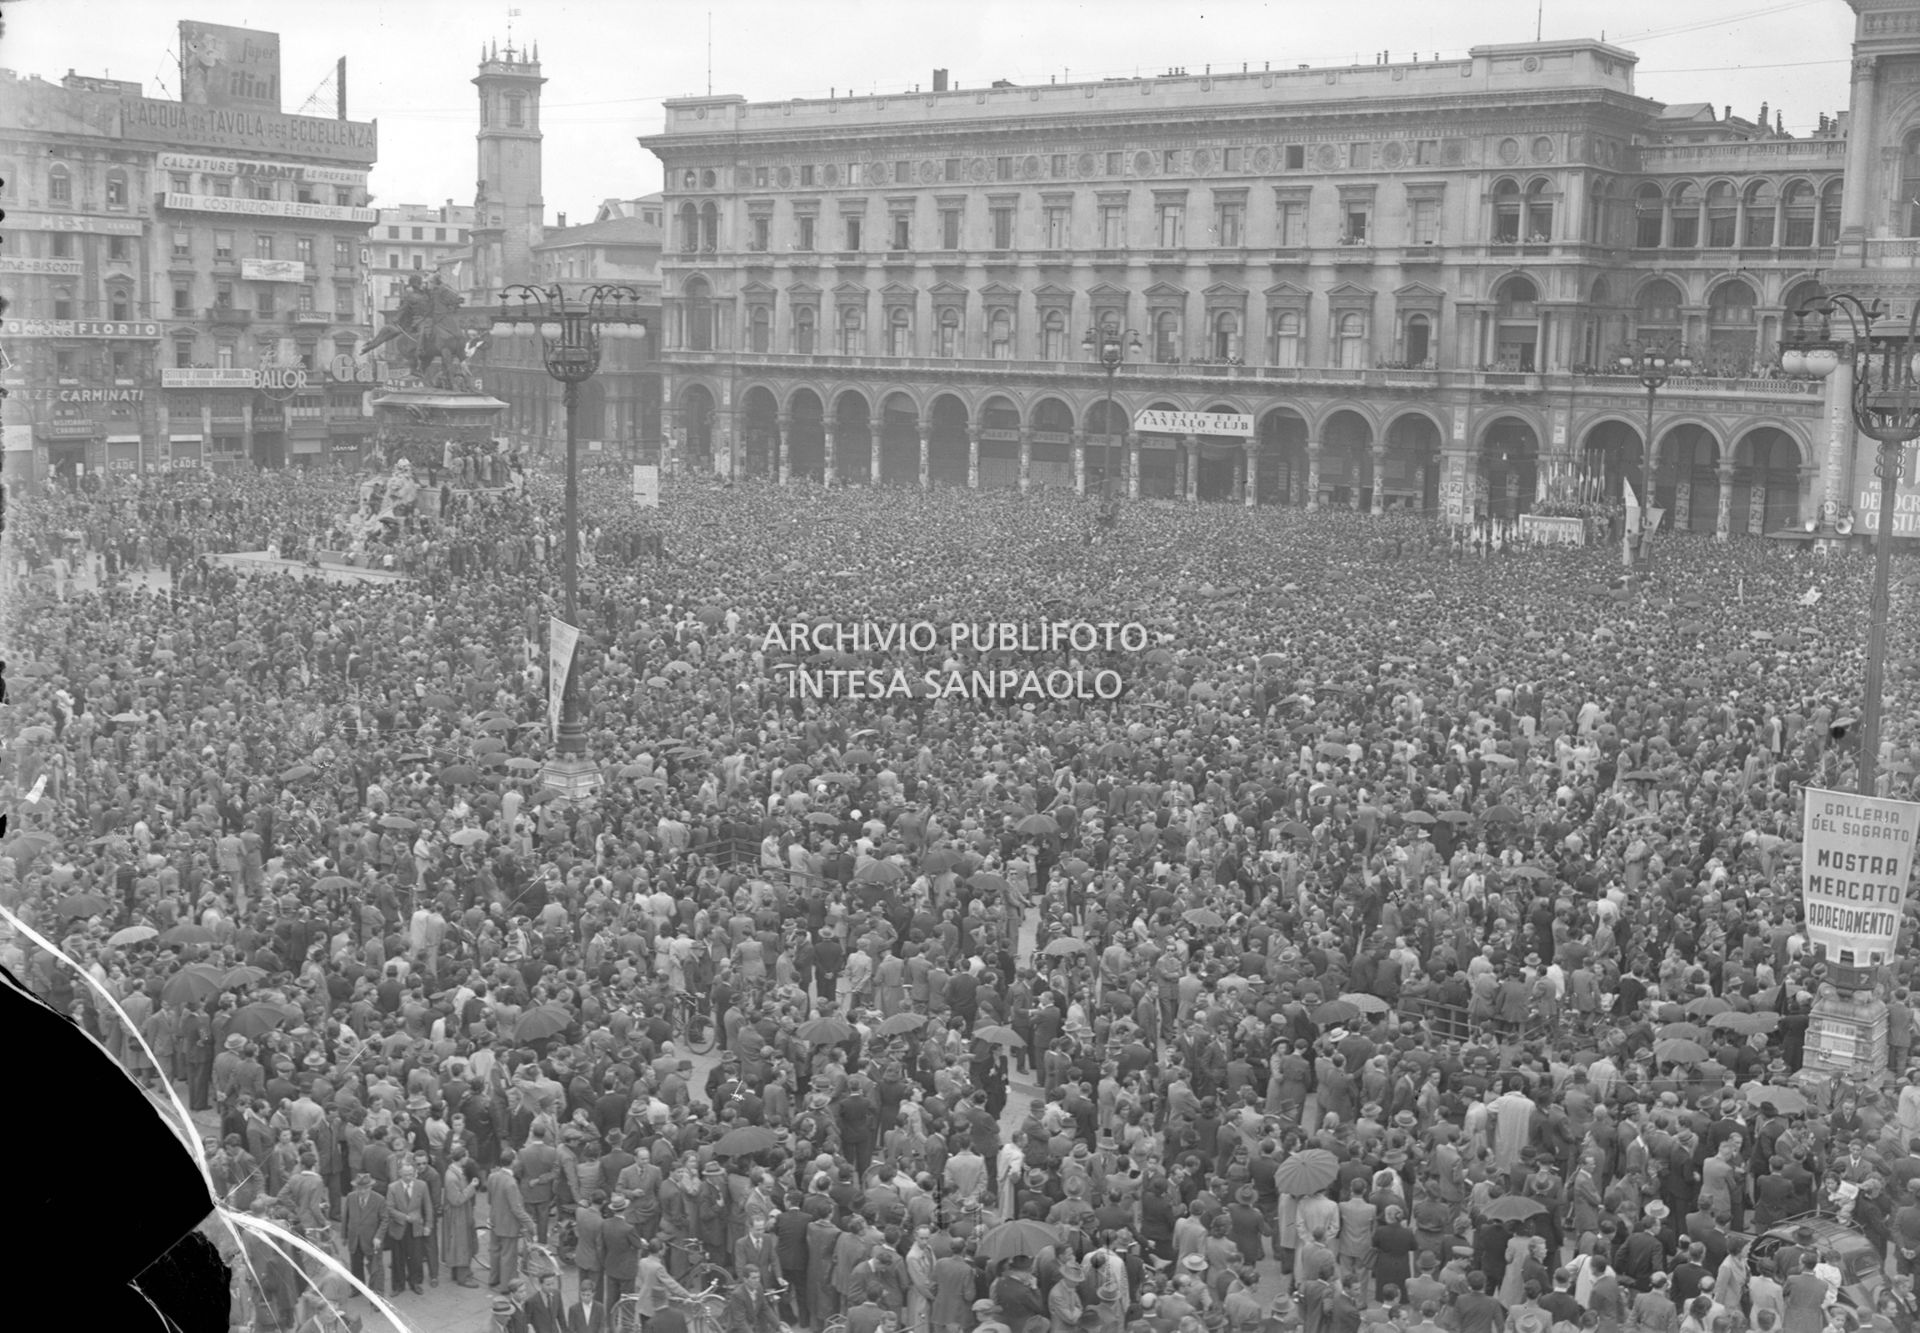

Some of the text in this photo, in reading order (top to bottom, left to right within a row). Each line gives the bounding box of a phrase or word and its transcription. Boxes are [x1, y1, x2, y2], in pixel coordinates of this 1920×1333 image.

[127, 102, 188, 129] L'ACQUA
[208, 109, 264, 137] TAVOLA
[268, 122, 287, 139] PER
[291, 119, 374, 148] ECCELLENZA
[162, 156, 235, 172] CALZATURE
[202, 197, 344, 219] COSTRUZIONI ELETTRICHE
[78, 322, 157, 336] FLORIO
[252, 369, 307, 389] BALLOR
[60, 389, 144, 402] CARMINATI
[172, 459, 199, 469] CADE
[1825, 803, 1900, 825] GALLERIA
[1811, 818, 1910, 842] DEL SAGRATO
[1817, 848, 1898, 876] MOSTRA
[1809, 874, 1900, 905] MERCATO
[1809, 903, 1895, 936] ARREDAMENTO
